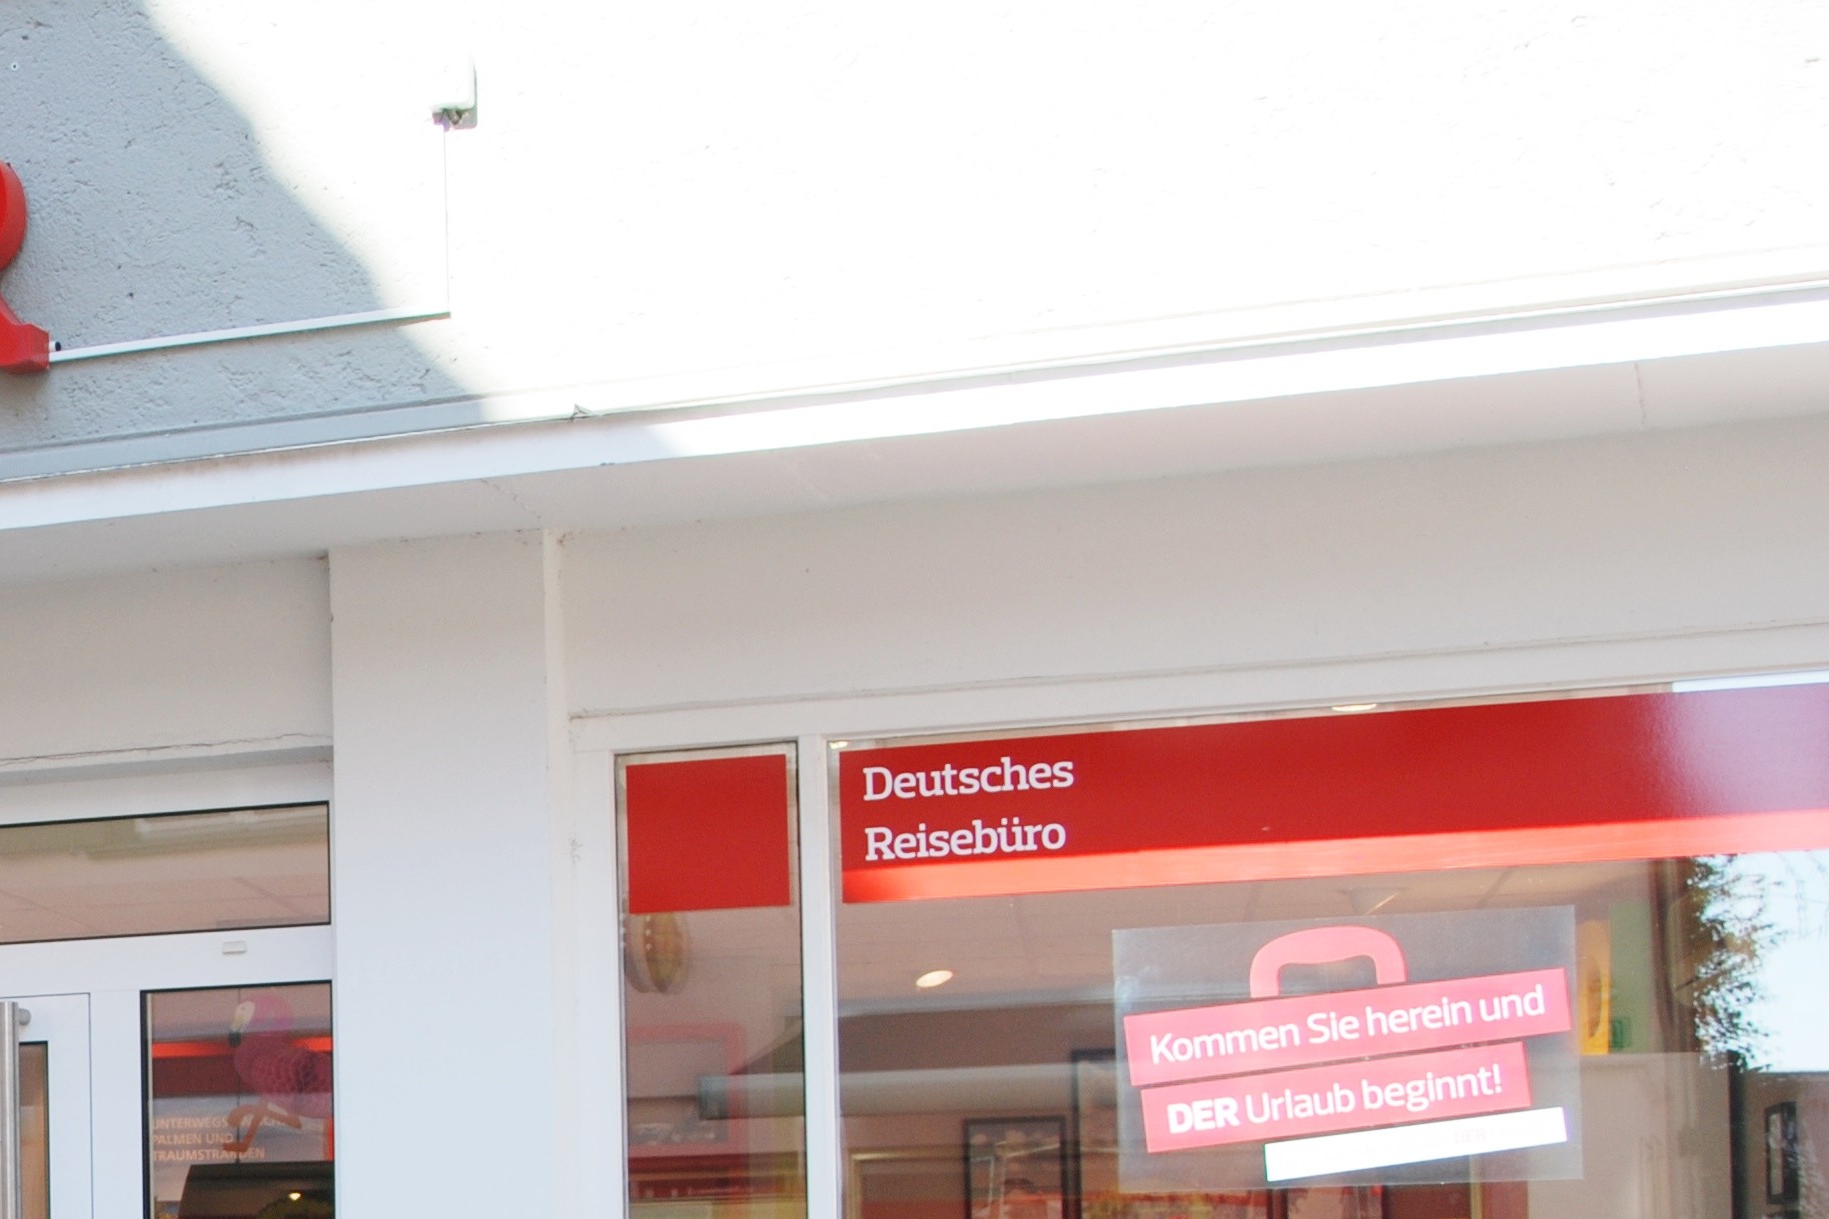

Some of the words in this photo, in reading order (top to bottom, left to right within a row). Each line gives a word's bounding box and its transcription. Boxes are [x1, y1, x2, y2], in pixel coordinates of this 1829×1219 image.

[863, 756, 1074, 801] Deutsches
[864, 817, 1066, 861] Reisebüro
[1149, 1021, 1301, 1065] Kommen
[1306, 1011, 1361, 1045] Sie
[1365, 997, 1472, 1037] herein
[1479, 983, 1545, 1022] und
[1167, 1097, 1240, 1134] DER
[1245, 1082, 1356, 1125] Urlaub
[1361, 1063, 1503, 1112] beginnt!
